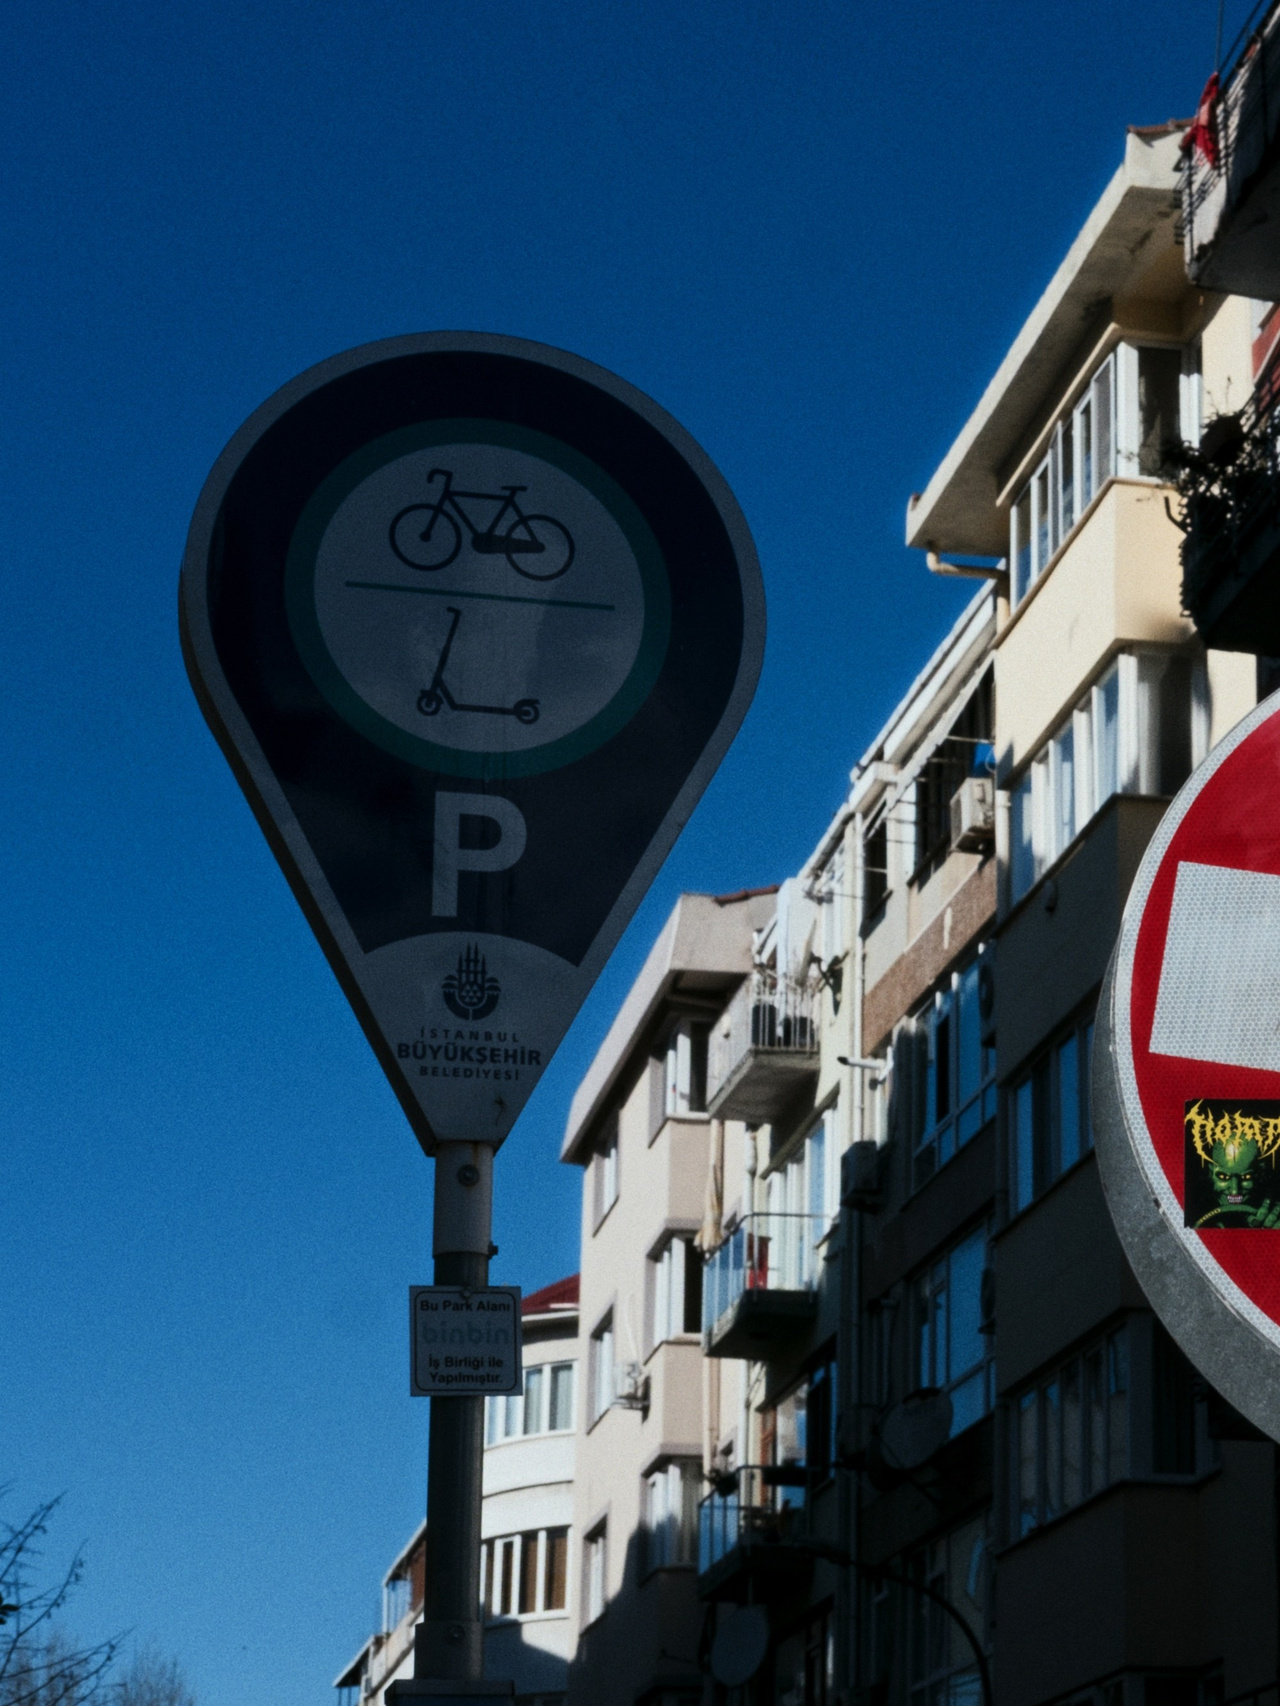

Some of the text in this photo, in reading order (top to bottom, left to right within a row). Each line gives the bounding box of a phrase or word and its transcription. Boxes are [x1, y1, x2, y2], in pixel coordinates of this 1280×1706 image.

[431, 790, 528, 918] P
[420, 1027, 519, 1043] İSTANBUL
[397, 1042, 542, 1066] BÜYÜKŞEHİR
[419, 1065, 520, 1081] BELEDİYESİ
[420, 1300, 510, 1312] Bu Park Alanı
[422, 1321, 511, 1345] binbin
[429, 1354, 504, 1370] İş Birliği ile
